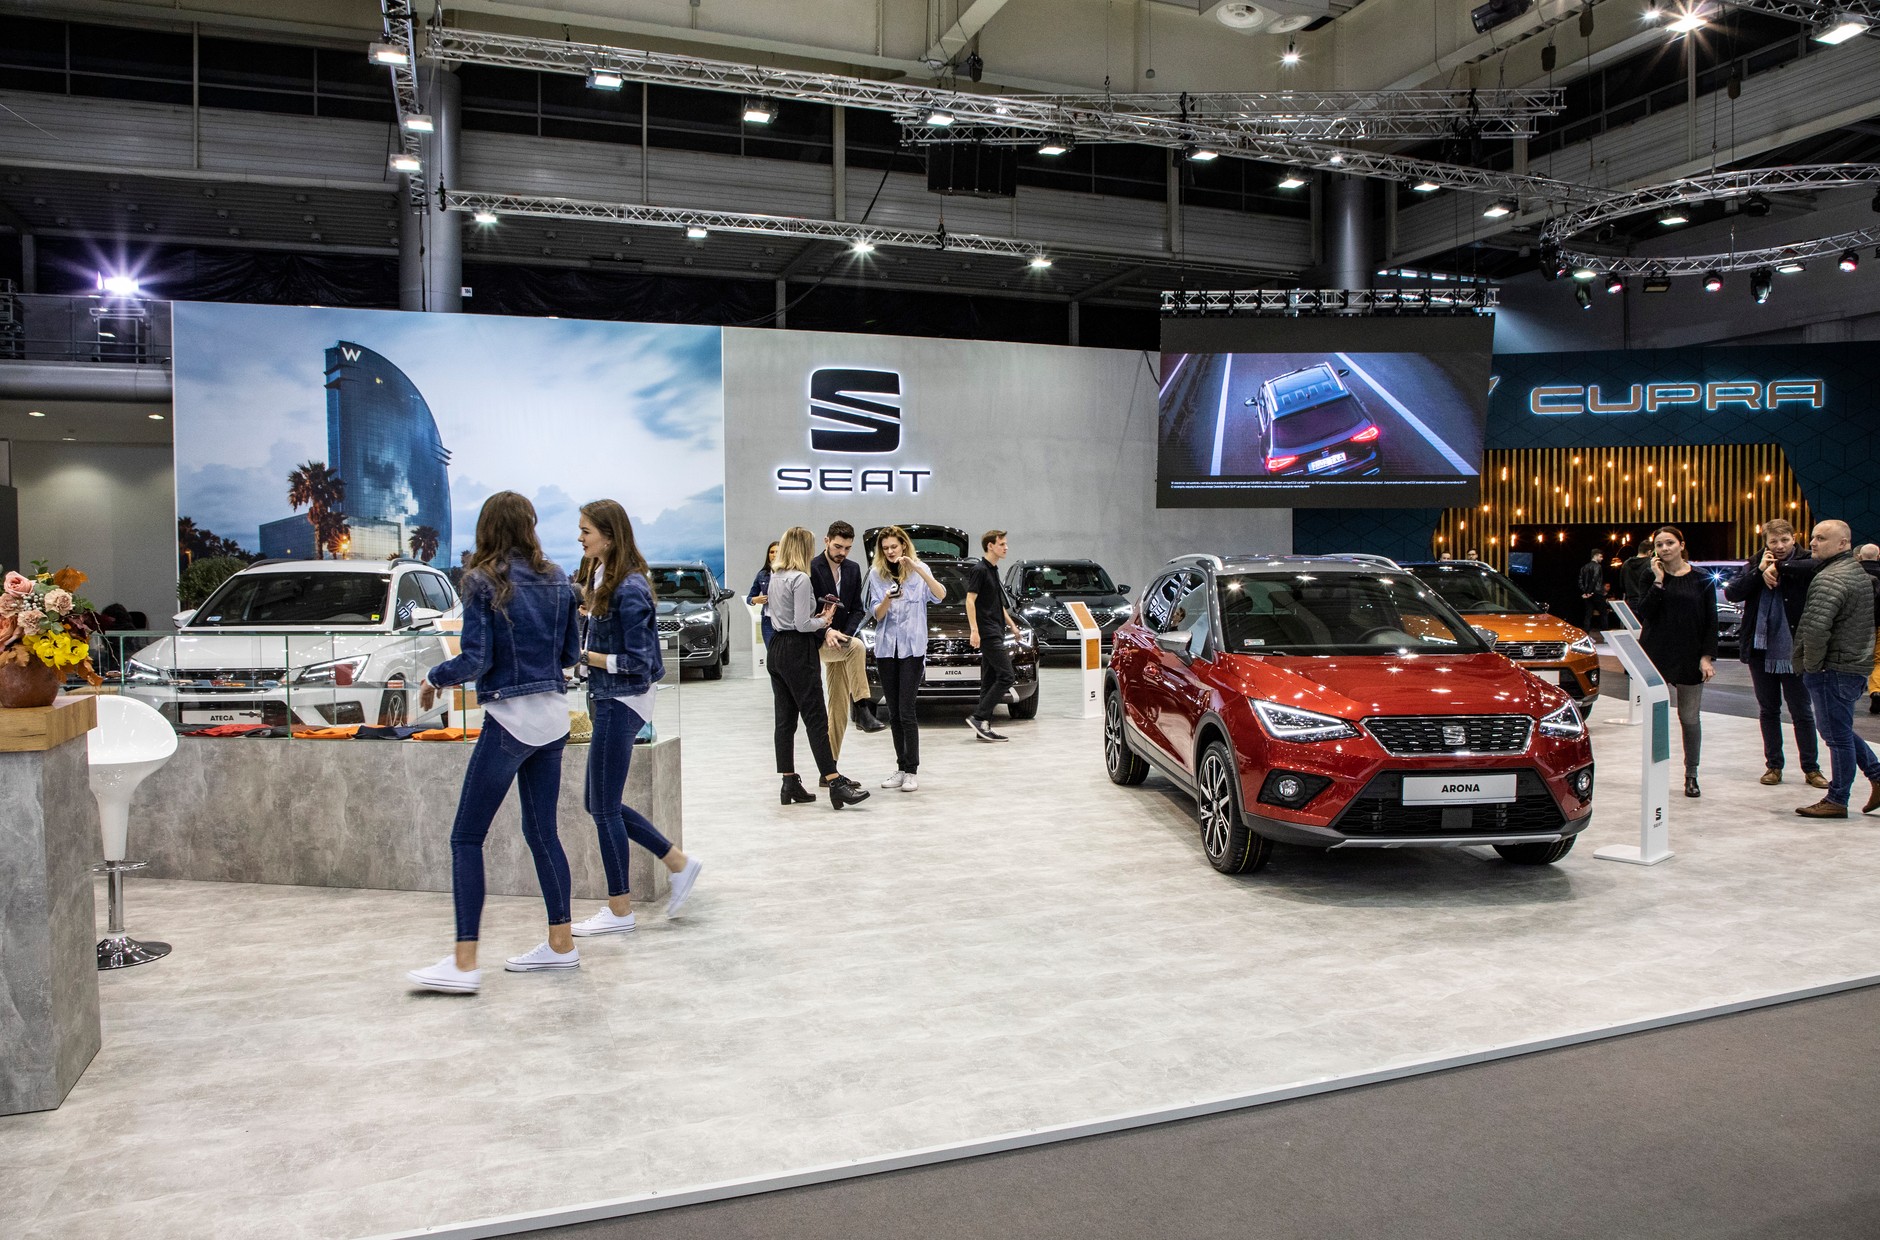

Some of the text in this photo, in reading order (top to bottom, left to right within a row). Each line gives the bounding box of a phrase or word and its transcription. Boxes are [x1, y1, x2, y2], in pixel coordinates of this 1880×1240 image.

[341, 346, 362, 362] W
[1529, 378, 1825, 415] CUPRA
[776, 467, 931, 493] SEAT
[209, 714, 235, 722] ATECA
[1440, 783, 1481, 793] ARONA
